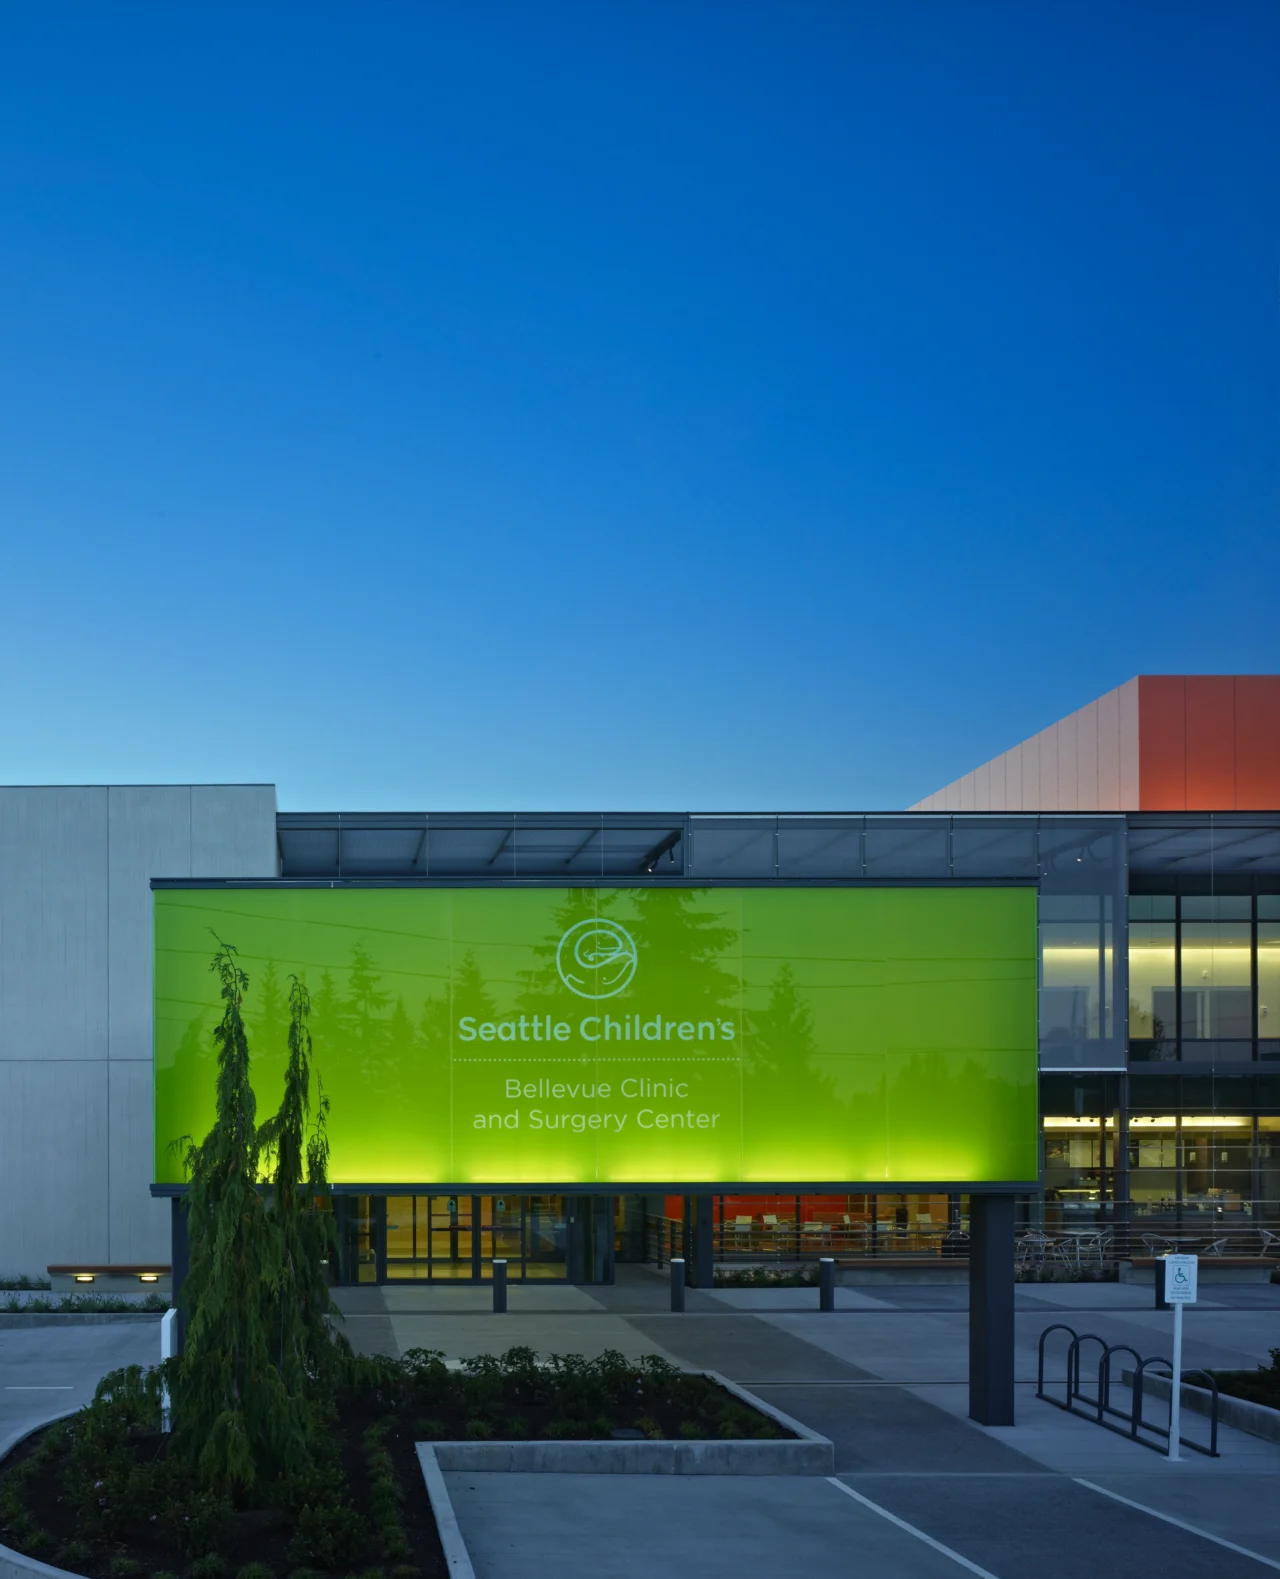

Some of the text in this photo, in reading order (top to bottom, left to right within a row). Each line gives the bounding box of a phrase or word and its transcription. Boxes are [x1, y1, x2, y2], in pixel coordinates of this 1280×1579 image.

[458, 1014, 736, 1042] Seattle Children's
[505, 1078, 689, 1099] Bellevue Clinic
[473, 1109, 721, 1133] and Surgery Center
